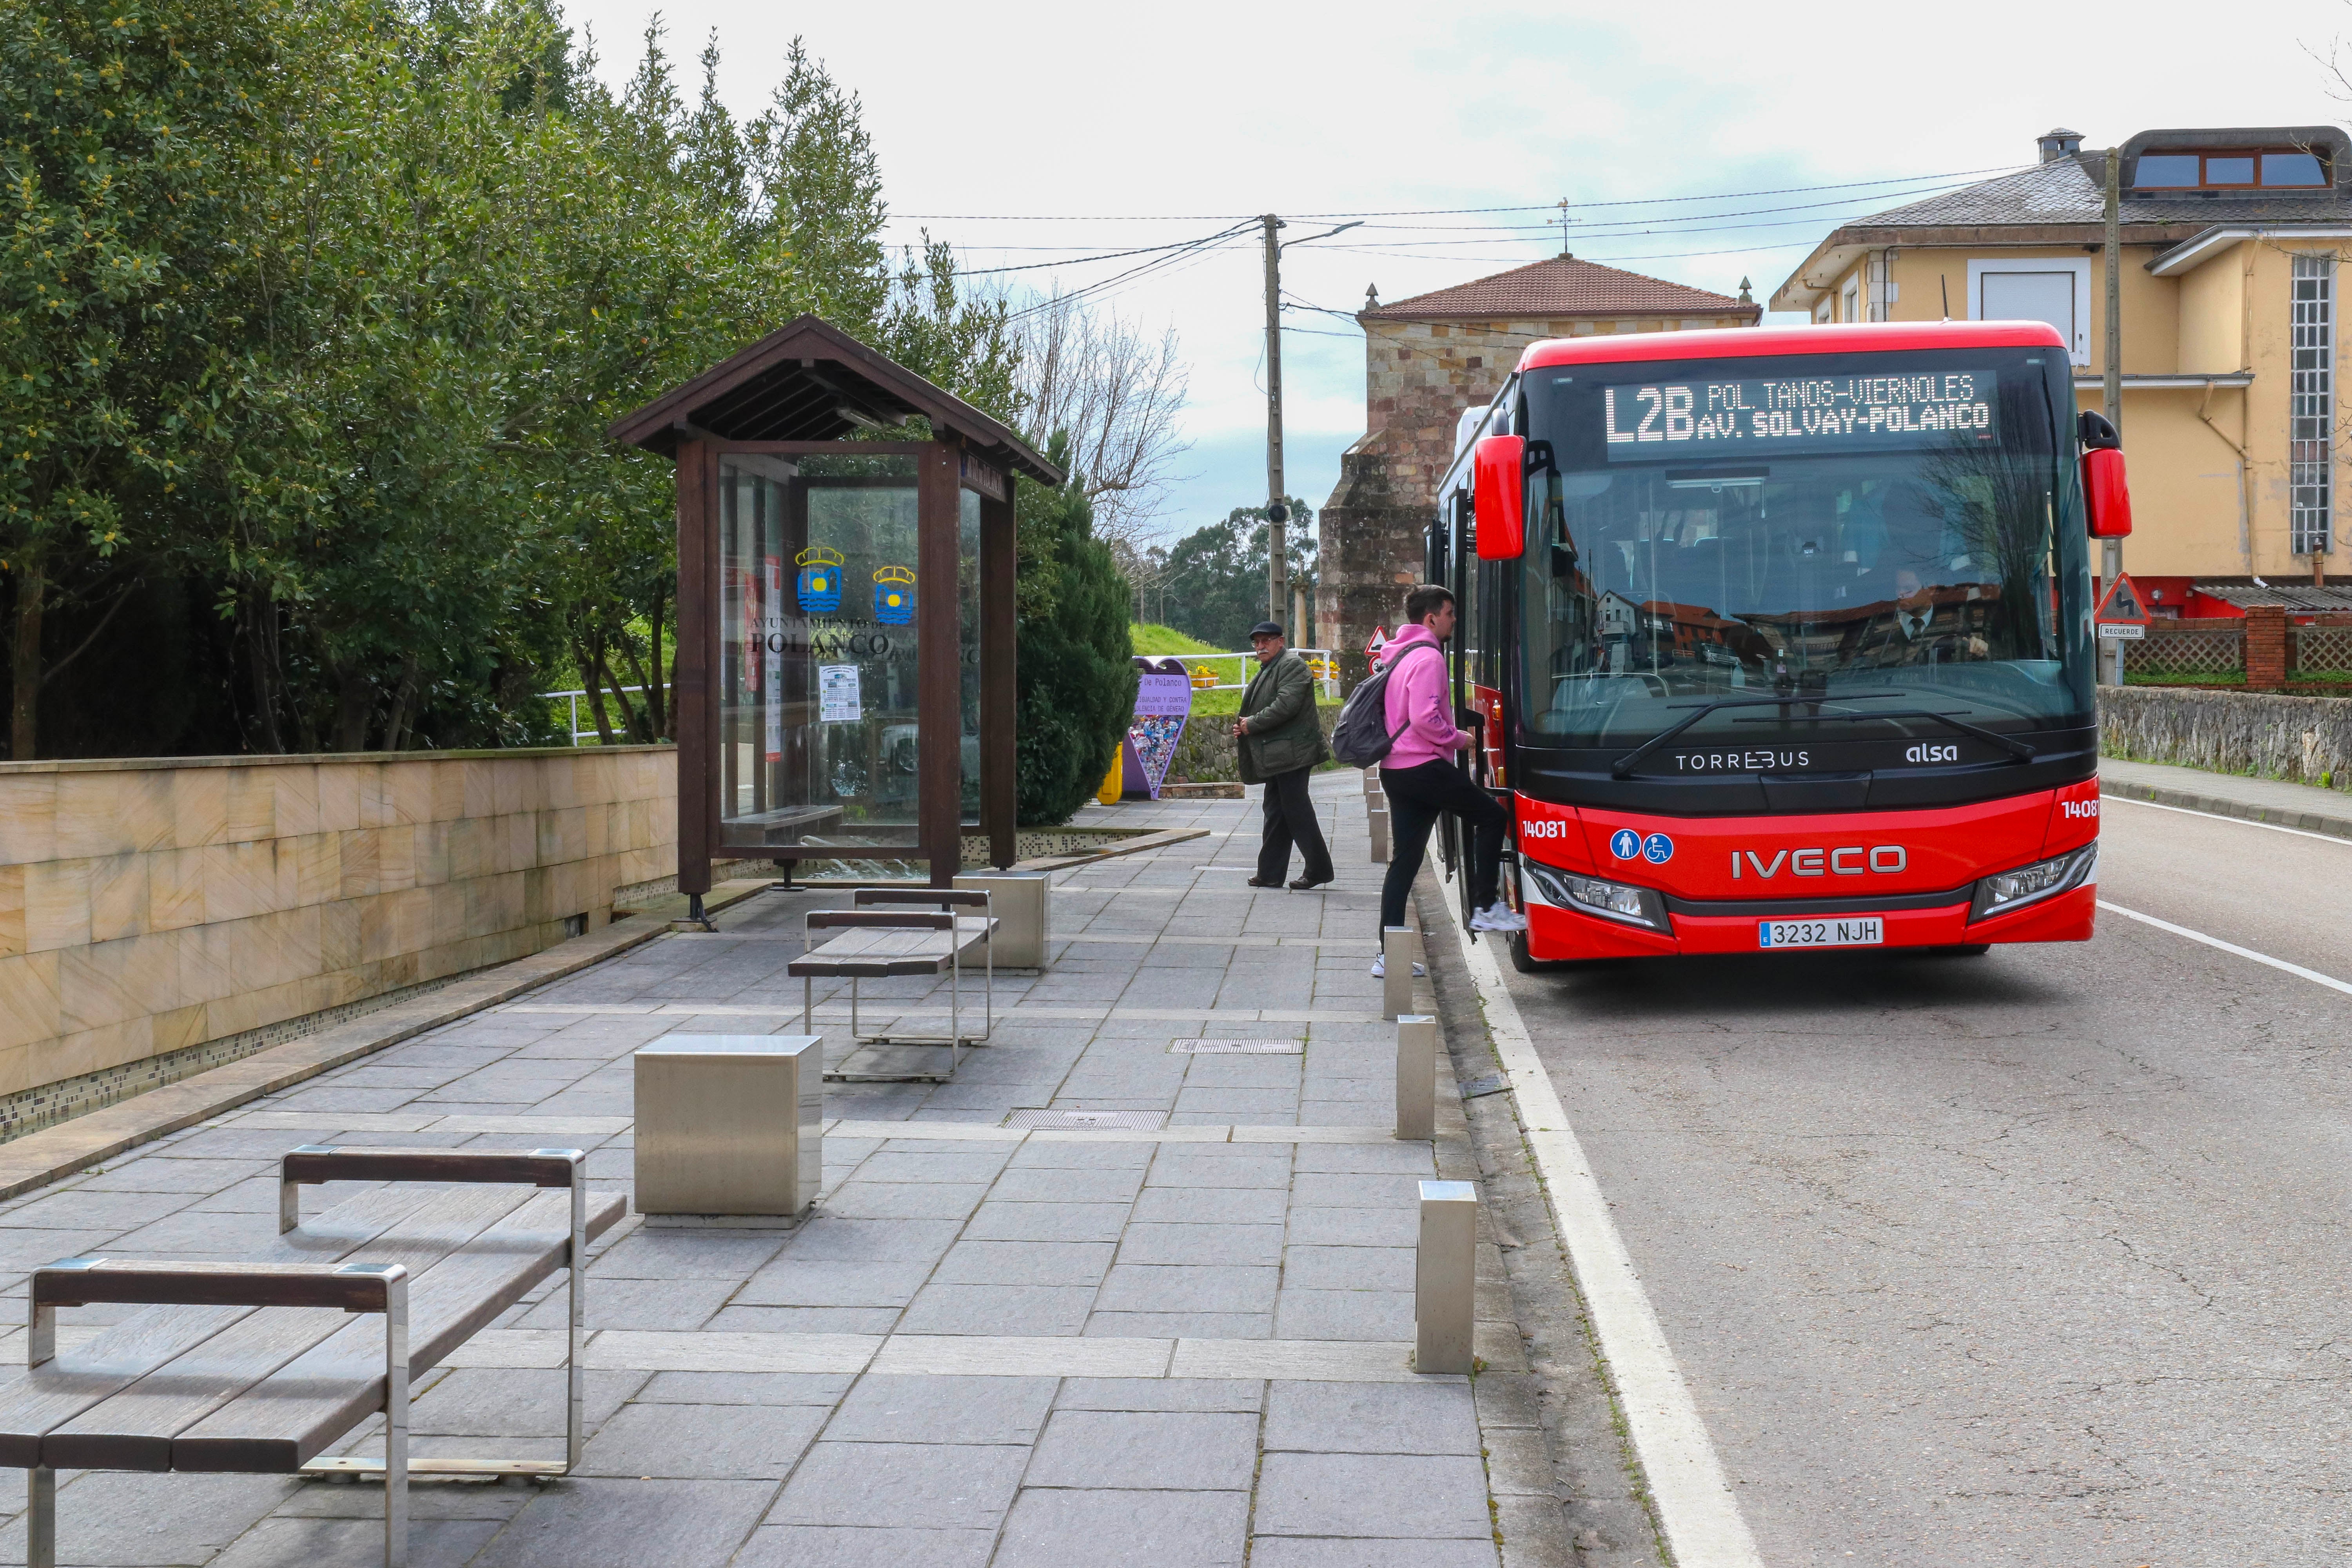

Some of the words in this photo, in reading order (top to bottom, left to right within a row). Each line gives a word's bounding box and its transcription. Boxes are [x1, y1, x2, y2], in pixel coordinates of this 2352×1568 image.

[1708, 385, 1755, 411] POL.
[1763, 375, 1974, 409] TANOS-VIERNOLES
[1605, 386, 1694, 443] L2B
[1697, 413, 1742, 439] AV.
[1752, 403, 1989, 437] SOLVAY-POLANCO
[750, 618, 866, 629] AYUNTAMIENTO
[750, 633, 889, 654] POLANCO
[1676, 751, 1809, 770] TORREBUS
[1906, 743, 1958, 762] alsa
[1522, 820, 1566, 838] 14081
[1731, 844, 1907, 879] IVECO
[1773, 923, 1827, 944] 3232
[1837, 921, 1877, 941] NJH
